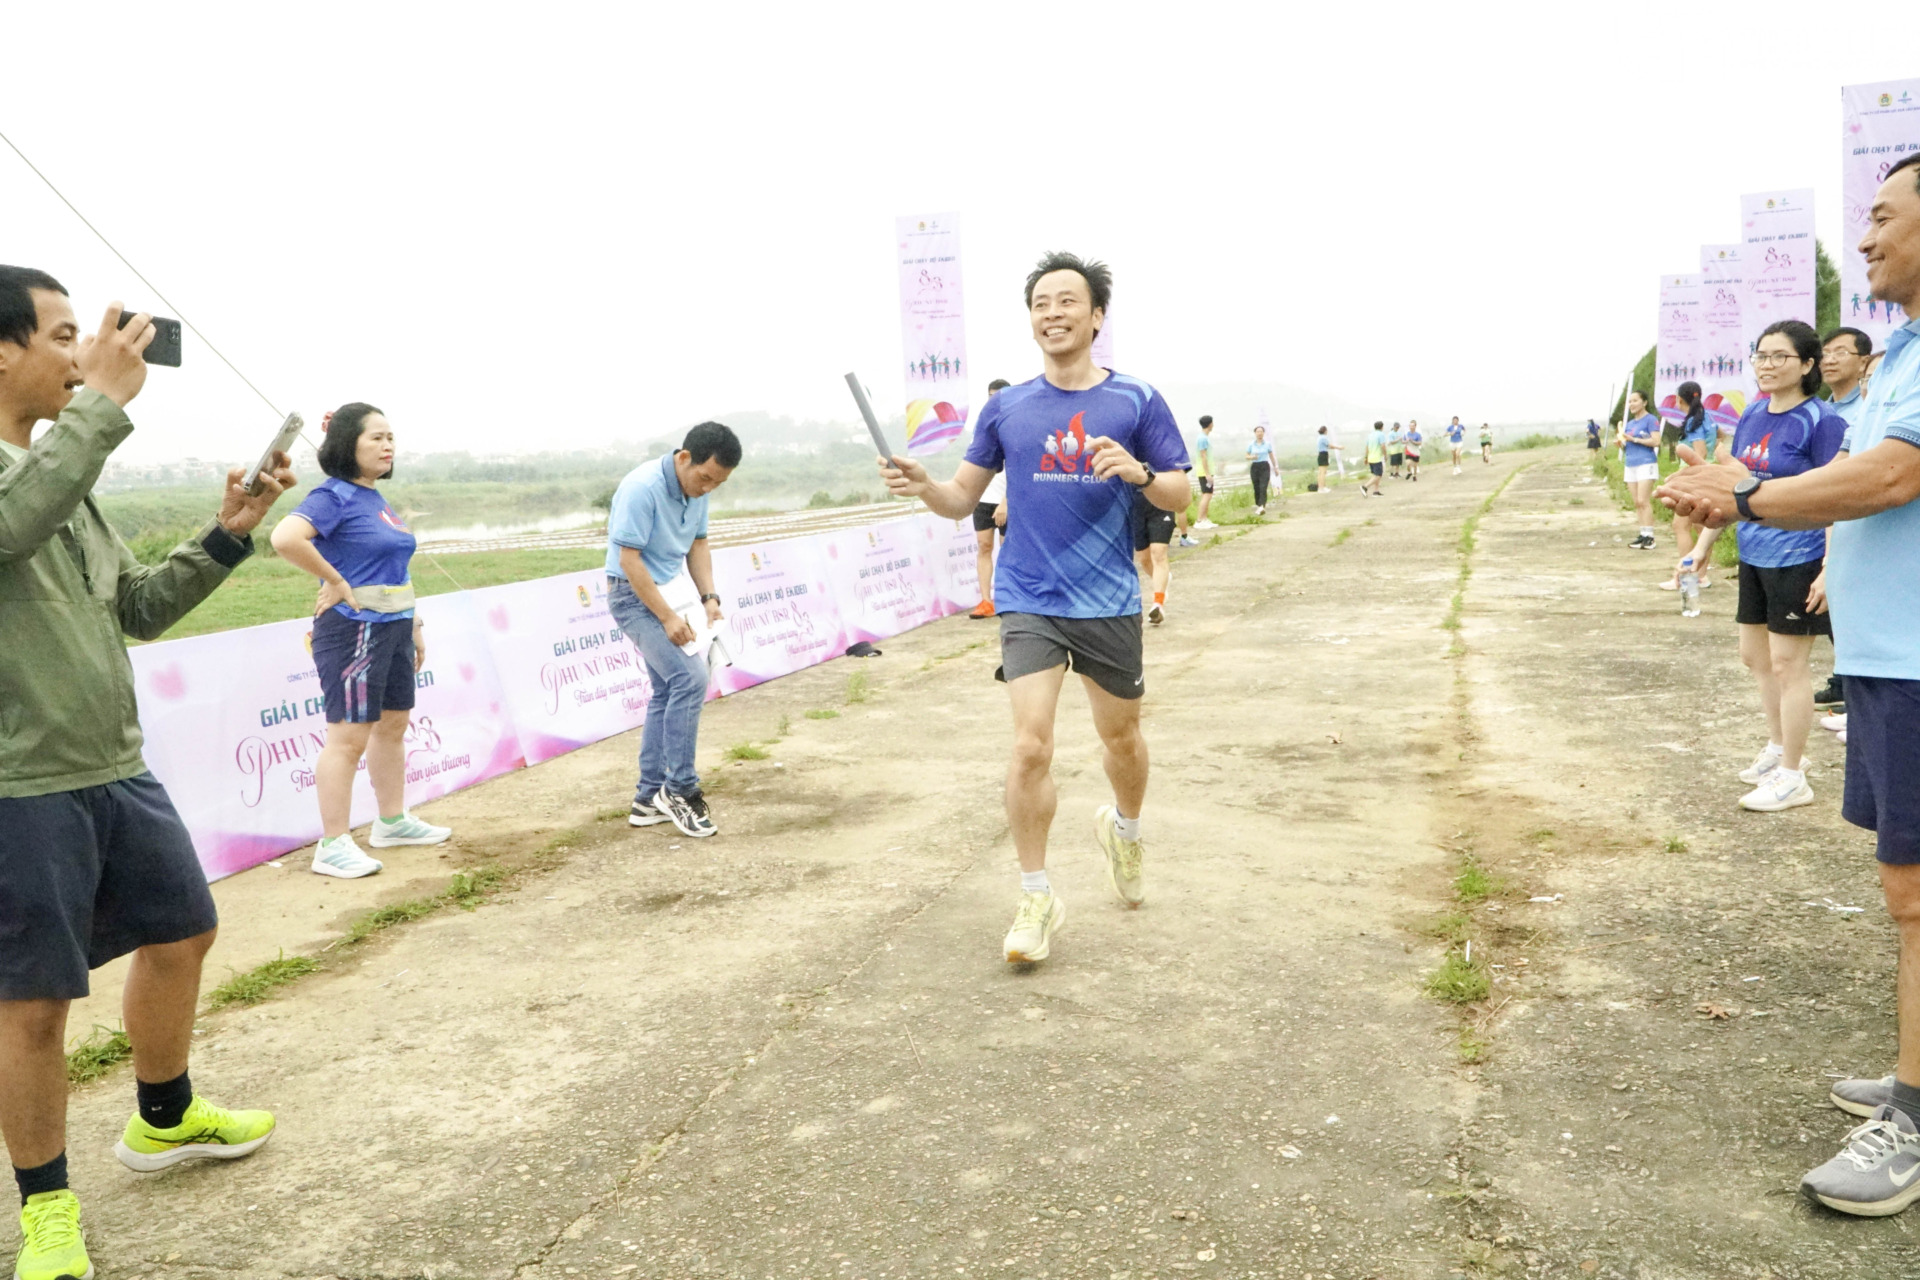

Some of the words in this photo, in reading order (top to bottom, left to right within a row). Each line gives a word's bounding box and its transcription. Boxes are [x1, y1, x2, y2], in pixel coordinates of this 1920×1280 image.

[1033, 473, 1080, 483] RUNNERS
[554, 636, 577, 657] GIẢI
[580, 632, 606, 650] CHẠY
[605, 651, 631, 672] BSR
[302, 672, 309, 680] TY
[260, 700, 298, 728] GIẢI
[236, 735, 308, 808] PHỤ
[291, 766, 316, 793] Trà
